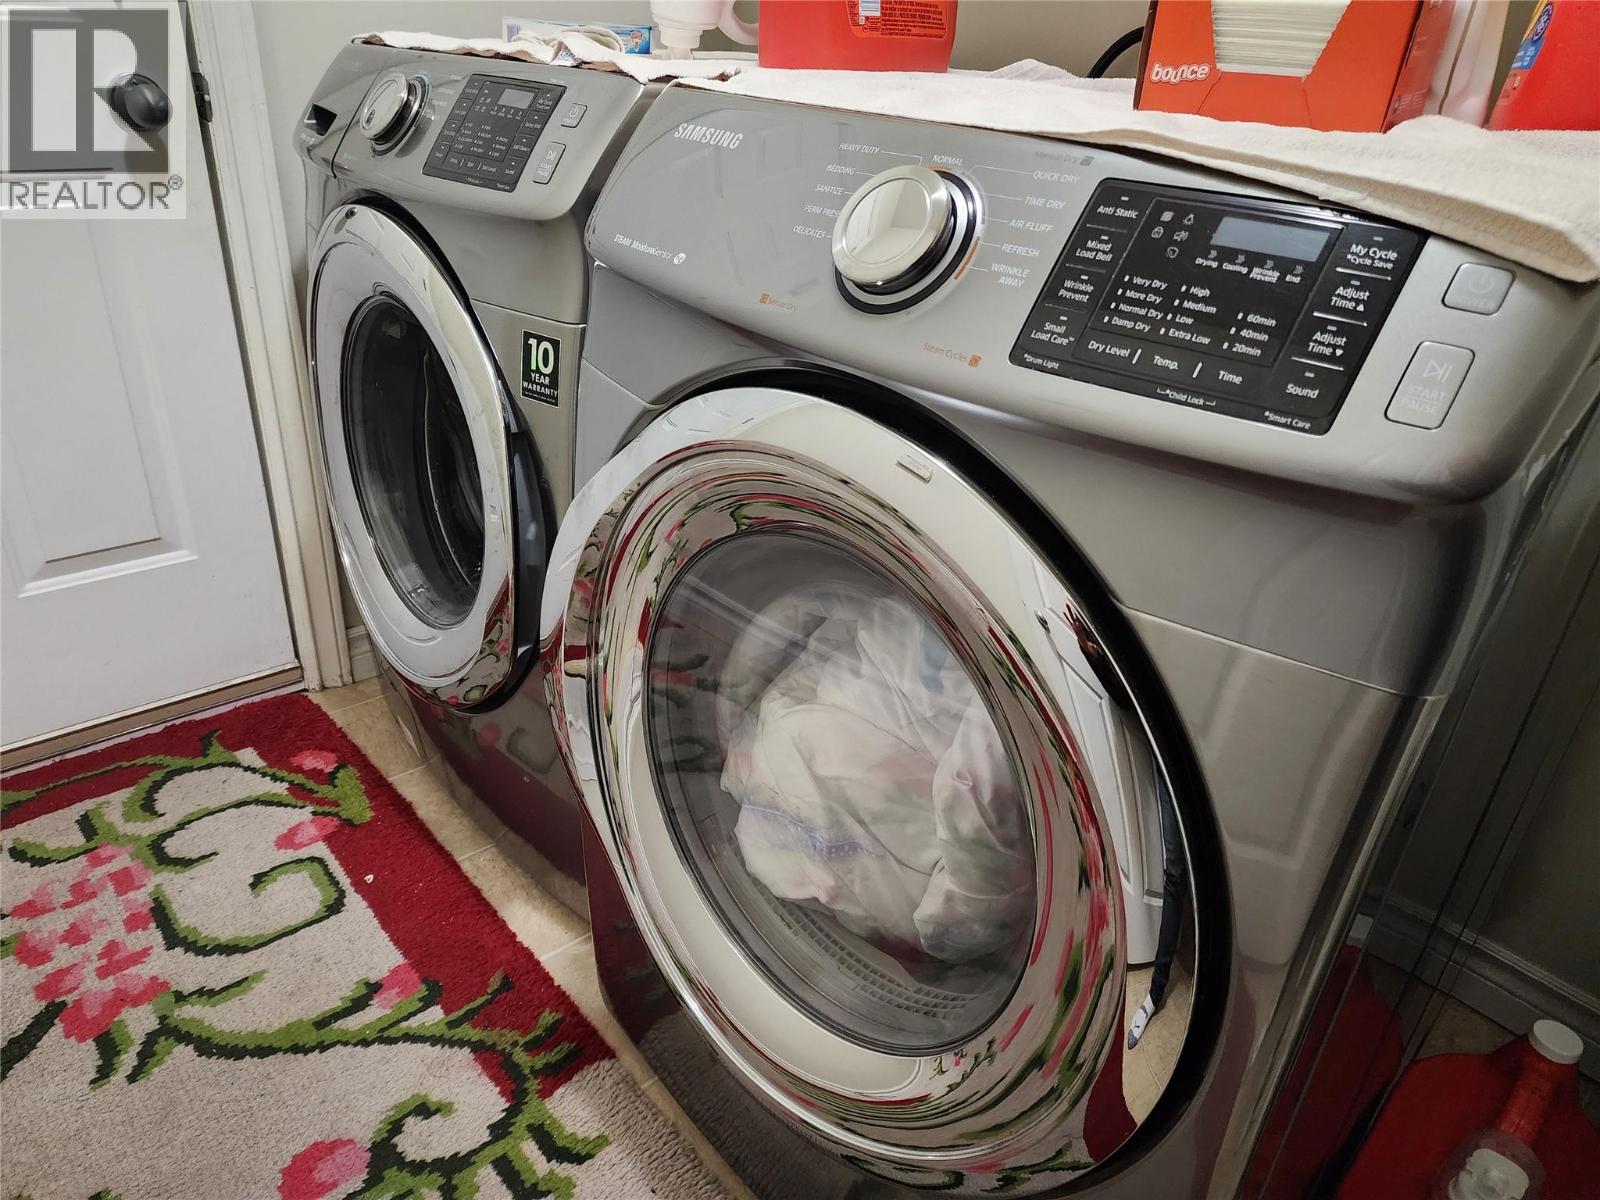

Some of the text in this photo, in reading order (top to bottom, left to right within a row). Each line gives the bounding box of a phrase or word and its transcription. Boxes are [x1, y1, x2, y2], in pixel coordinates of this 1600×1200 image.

[1151, 62, 1210, 84] bounce
[674, 122, 744, 149] SAMSUNG
[862, 145, 880, 154] DUTY
[932, 154, 963, 166] NORMAL
[827, 164, 856, 175] BEDDING
[1032, 170, 1080, 183] QUICK DRY
[815, 184, 844, 196] SANITIZE
[804, 204, 823, 215] PERM
[1024, 197, 1066, 209] TIME DRY
[1097, 205, 1139, 219] Anti Static
[793, 225, 826, 239] DELICATES
[1009, 219, 1054, 232] AIR FLUFF
[613, 234, 632, 247] STEAM
[1086, 240, 1112, 251] Mixed
[1001, 243, 1040, 257] REFRESH
[1076, 248, 1113, 262] Load Bell
[1350, 243, 1398, 261] My Cycle
[1195, 257, 1219, 268] Drying
[1222, 263, 1248, 274] Cooling
[1372, 258, 1393, 270] Save
[992, 263, 1030, 277] WRINKLE
[1252, 267, 1280, 277] Wrinkle
[998, 276, 1024, 287] AWAY
[1132, 276, 1168, 291] Very Dry
[1249, 273, 1278, 283] Prevent
[1285, 274, 1301, 283] End
[1063, 280, 1094, 293] Wrinkle
[1189, 285, 1210, 298] High
[1058, 290, 1089, 303] Prevent
[1125, 289, 1163, 305] More Dry
[1335, 286, 1370, 302] Adjust
[1182, 300, 1217, 314] Medium
[1330, 296, 1355, 310] Time
[1118, 303, 1163, 319] Normal Dry
[1111, 317, 1151, 333] Damp Dry
[1175, 314, 1194, 325] Low
[1246, 314, 1276, 328] 60min
[1044, 322, 1066, 333] Small
[1031, 330, 1051, 341] Load
[1168, 328, 1211, 345] Extra Low
[1239, 328, 1269, 343] 40min
[1312, 331, 1347, 347] Adjust
[1088, 340, 1130, 358] Dry Level
[1232, 343, 1261, 357] 20min
[1307, 342, 1333, 356] Time
[528, 338, 555, 375] 10
[1152, 355, 1179, 370] Temp.
[1043, 359, 1059, 369] Light
[530, 372, 550, 386] YEAR
[1218, 370, 1243, 385] Time
[522, 381, 558, 397] WARRANTY
[1286, 384, 1319, 399] Sound
[1408, 384, 1447, 400] START
[1187, 396, 1205, 406] Lock
[1292, 417, 1312, 430] Care
